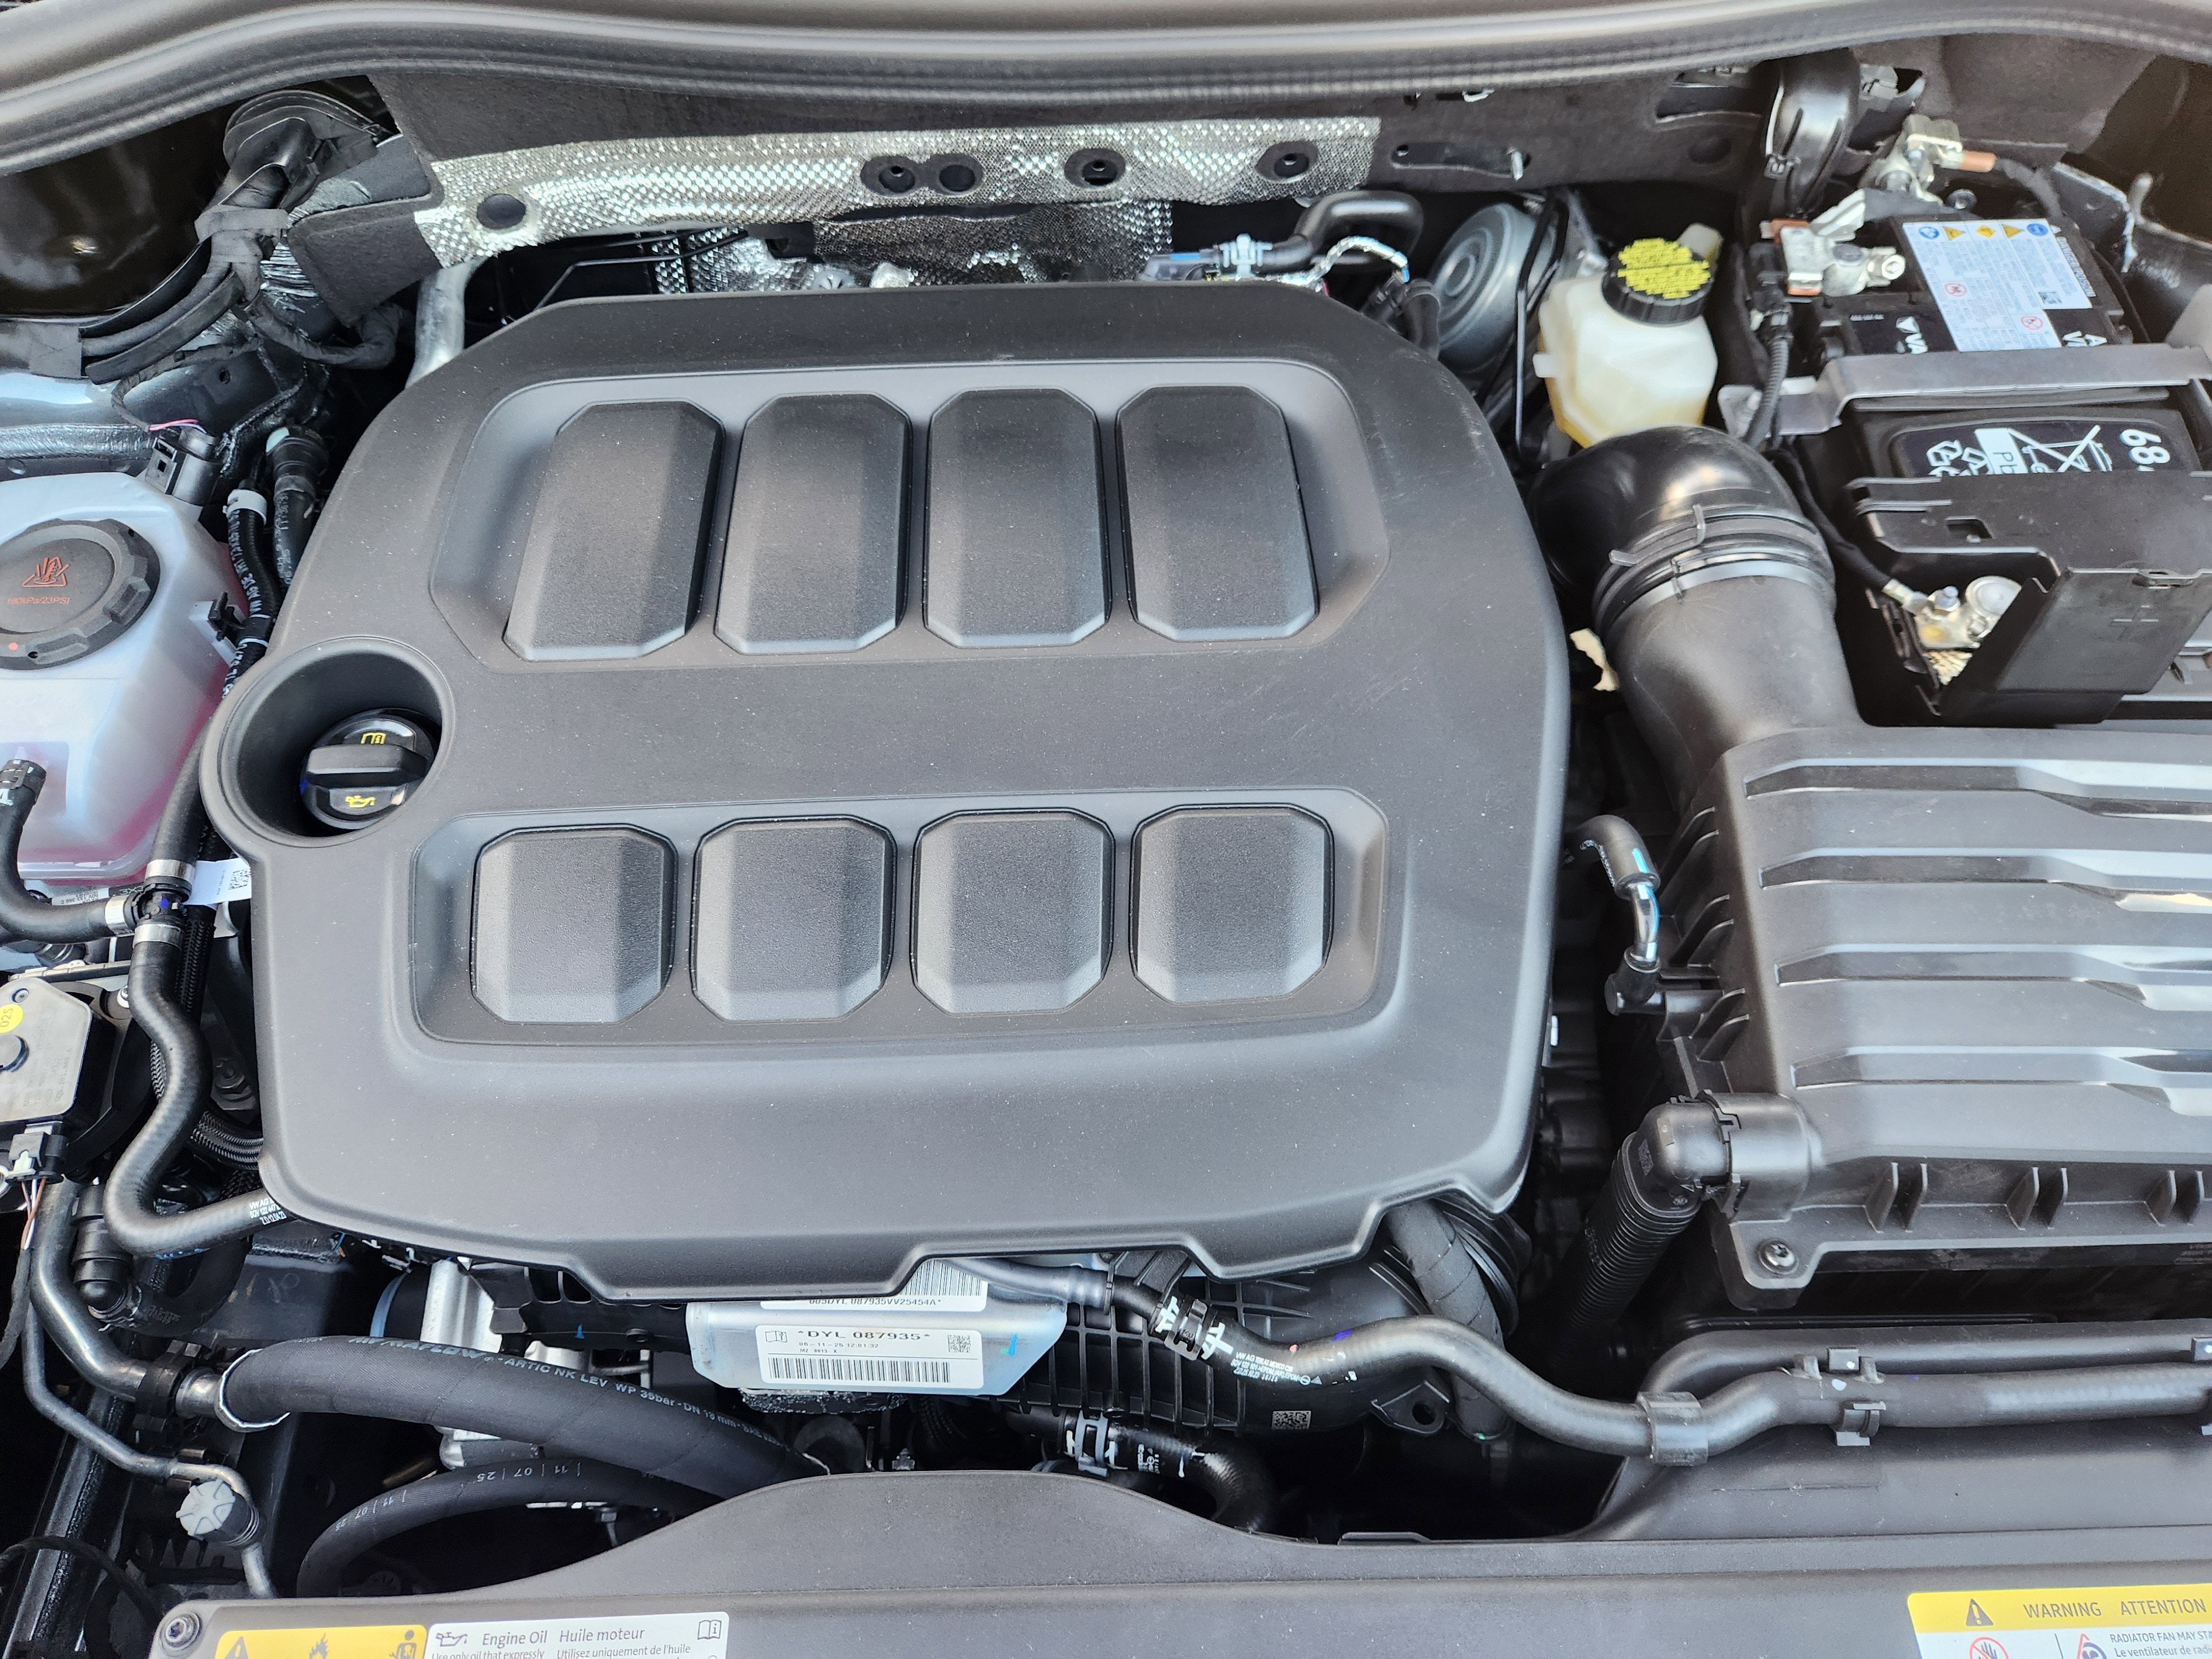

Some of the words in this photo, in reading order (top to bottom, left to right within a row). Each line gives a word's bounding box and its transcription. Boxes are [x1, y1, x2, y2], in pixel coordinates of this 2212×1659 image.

[504, 1357, 550, 1374] ARTIC
[554, 1367, 576, 1380] NK
[580, 1373, 609, 1388] LEV
[476, 1470, 495, 1483] 25
[513, 1467, 533, 1478] 07
[2023, 1601, 2102, 1619] WARNING
[2120, 1598, 2207, 1616] ATTENTION
[482, 1632, 526, 1649] Engine
[529, 1630, 548, 1644] Oil
[559, 1628, 593, 1642] Huile
[597, 1627, 645, 1641] moteur
[2109, 1633, 2157, 1644] RADIATOR
[2157, 1632, 2176, 1642] FAN
[2177, 1631, 2196, 1641] MAY
[483, 1651, 502, 1659] that
[503, 1648, 545, 1659] expressly
[557, 1648, 590, 1659] Utilisez
[592, 1646, 648, 1659] uniquement
[650, 1645, 661, 1655] de
[663, 1644, 691, 1655] l'huile
[2114, 1647, 2126, 1658] Le
[2127, 1646, 2178, 1657] ventilateur
[2180, 1645, 2192, 1656] de
